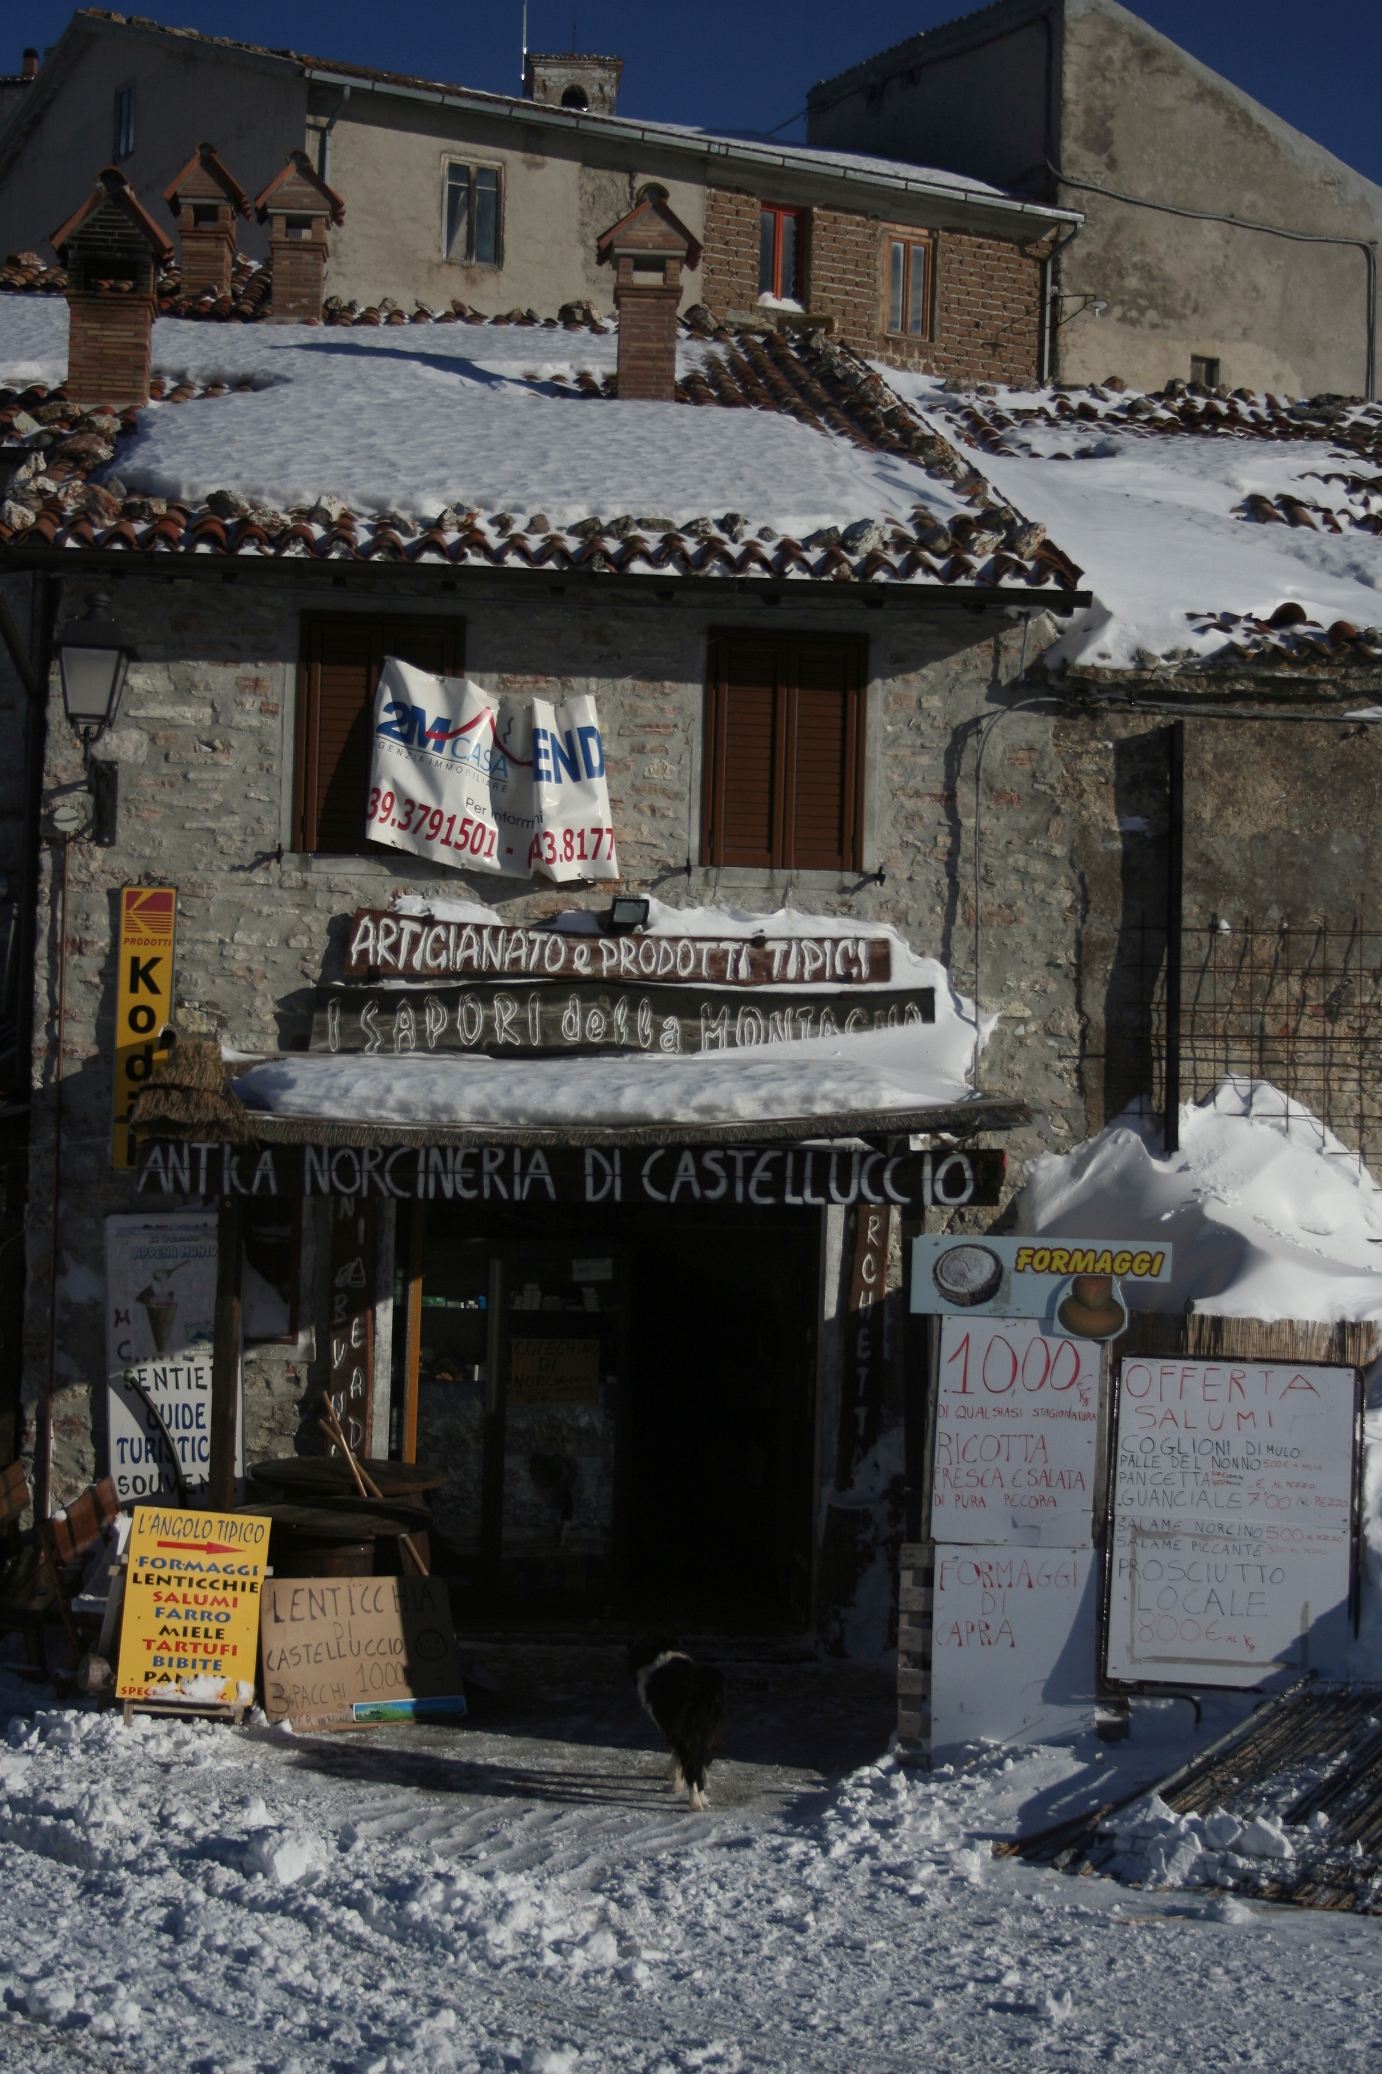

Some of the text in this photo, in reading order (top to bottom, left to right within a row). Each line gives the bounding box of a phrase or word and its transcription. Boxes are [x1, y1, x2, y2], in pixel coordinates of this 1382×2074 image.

[377, 701, 508, 778] 2M CASA
[429, 758, 508, 793] IMMOBILIARE
[466, 797, 488, 815] Per
[123, 936, 172, 947] PRODOTTI
[351, 914, 567, 972] ARTIGIANATO
[599, 936, 750, 981] PRODOTTI
[765, 938, 870, 981] TIPICI
[360, 991, 540, 1054] SAPORI
[125, 956, 164, 1166] Kod
[304, 1143, 557, 1200] NORCINERIA
[584, 1147, 622, 1202] DI
[641, 1148, 976, 1206] CASTELLUCCIO
[1015, 1246, 1166, 1277] FORMAGGI
[513, 1340, 599, 1356] COTECHINO
[330, 1293, 368, 1458] BEVAND
[538, 1357, 558, 1373] DI
[1125, 1364, 1321, 1403] OFFERTA
[937, 1403, 1097, 1422] DI QUALSIASI STAGIONATURA
[1135, 1405, 1273, 1432] SALUMI
[936, 1431, 1047, 1466] RICOTTA
[1120, 1434, 1300, 1459] COGLIONI DI MULO
[1120, 1454, 1161, 1469] PALLE
[1171, 1455, 1202, 1469] DEL
[1211, 1456, 1261, 1471] NONNO
[933, 1466, 1004, 1490] FRESCA
[1026, 1468, 1086, 1491] SALATA
[1119, 1471, 1210, 1488] PANCETTA
[934, 1492, 1057, 1508] DI PURA PECORA
[1121, 1489, 1242, 1510] GUANCIALE
[137, 1512, 265, 1544] L'ANGOLO TIPICO
[1116, 1518, 1182, 1532] SALAME
[1194, 1522, 1263, 1539] NORCINO
[1116, 1537, 1181, 1551] SALAME
[1191, 1540, 1263, 1557] PICCANTE
[138, 1555, 259, 1576] FORMAGGI
[940, 1558, 1077, 1591] FORMAGGI
[1118, 1557, 1285, 1585] PROSCIUTTO
[132, 1572, 259, 1594] LENTICCHIE
[153, 1590, 239, 1608] SALUMI
[273, 1582, 437, 1624] LENTICCHIA
[981, 1591, 1006, 1615] DI
[1137, 1586, 1268, 1617] LOCALE
[155, 1606, 231, 1623] FARRO
[158, 1624, 225, 1640] MIELE
[333, 1620, 353, 1642] DI
[934, 1619, 1016, 1648] CAPRA
[142, 1638, 238, 1657] TARTUFI
[266, 1637, 405, 1672] CASTELLUCCIO
[152, 1655, 223, 1671] BIBITE
[269, 1681, 347, 1714] 3 PACCHI
